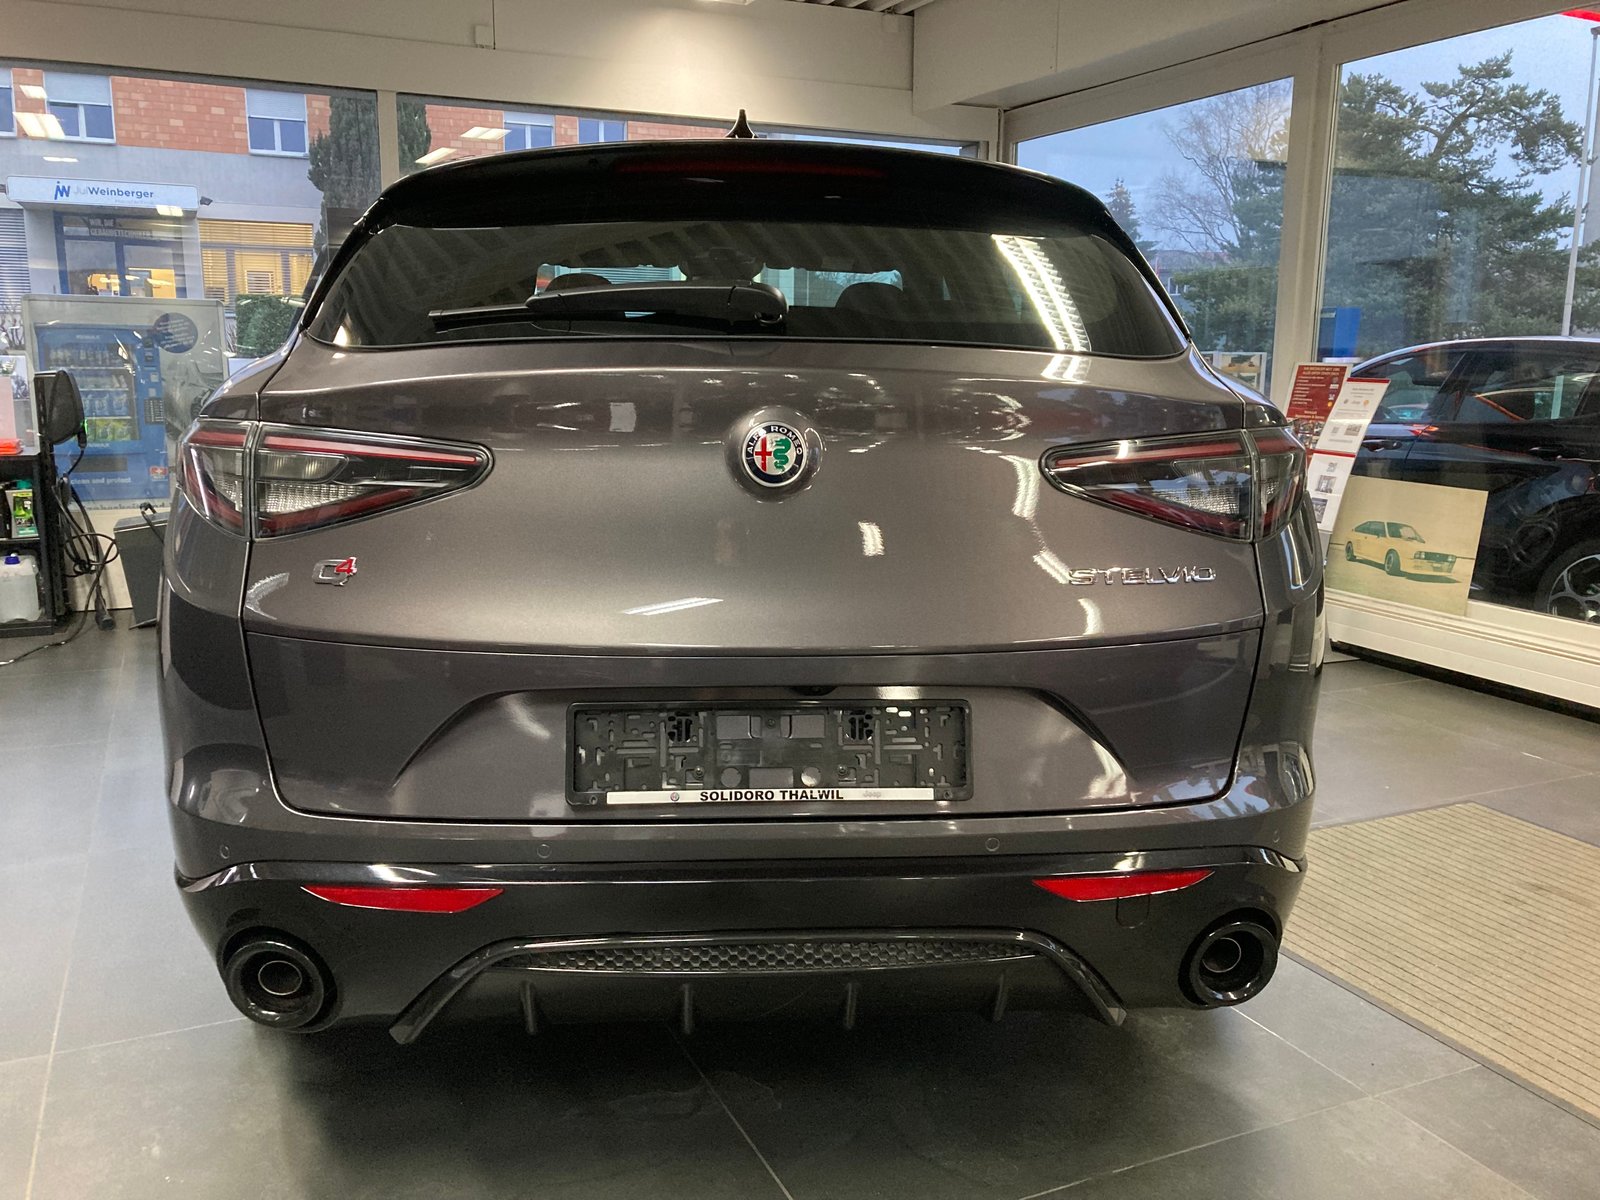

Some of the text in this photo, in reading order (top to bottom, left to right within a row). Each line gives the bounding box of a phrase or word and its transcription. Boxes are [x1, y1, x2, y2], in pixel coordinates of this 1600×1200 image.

[747, 425, 803, 455] ALF ROMEO
[312, 556, 357, 587] Q4
[1068, 566, 1217, 586] STELVIO
[700, 790, 775, 802] SOLIDORO
[780, 789, 844, 801] THALWIL
